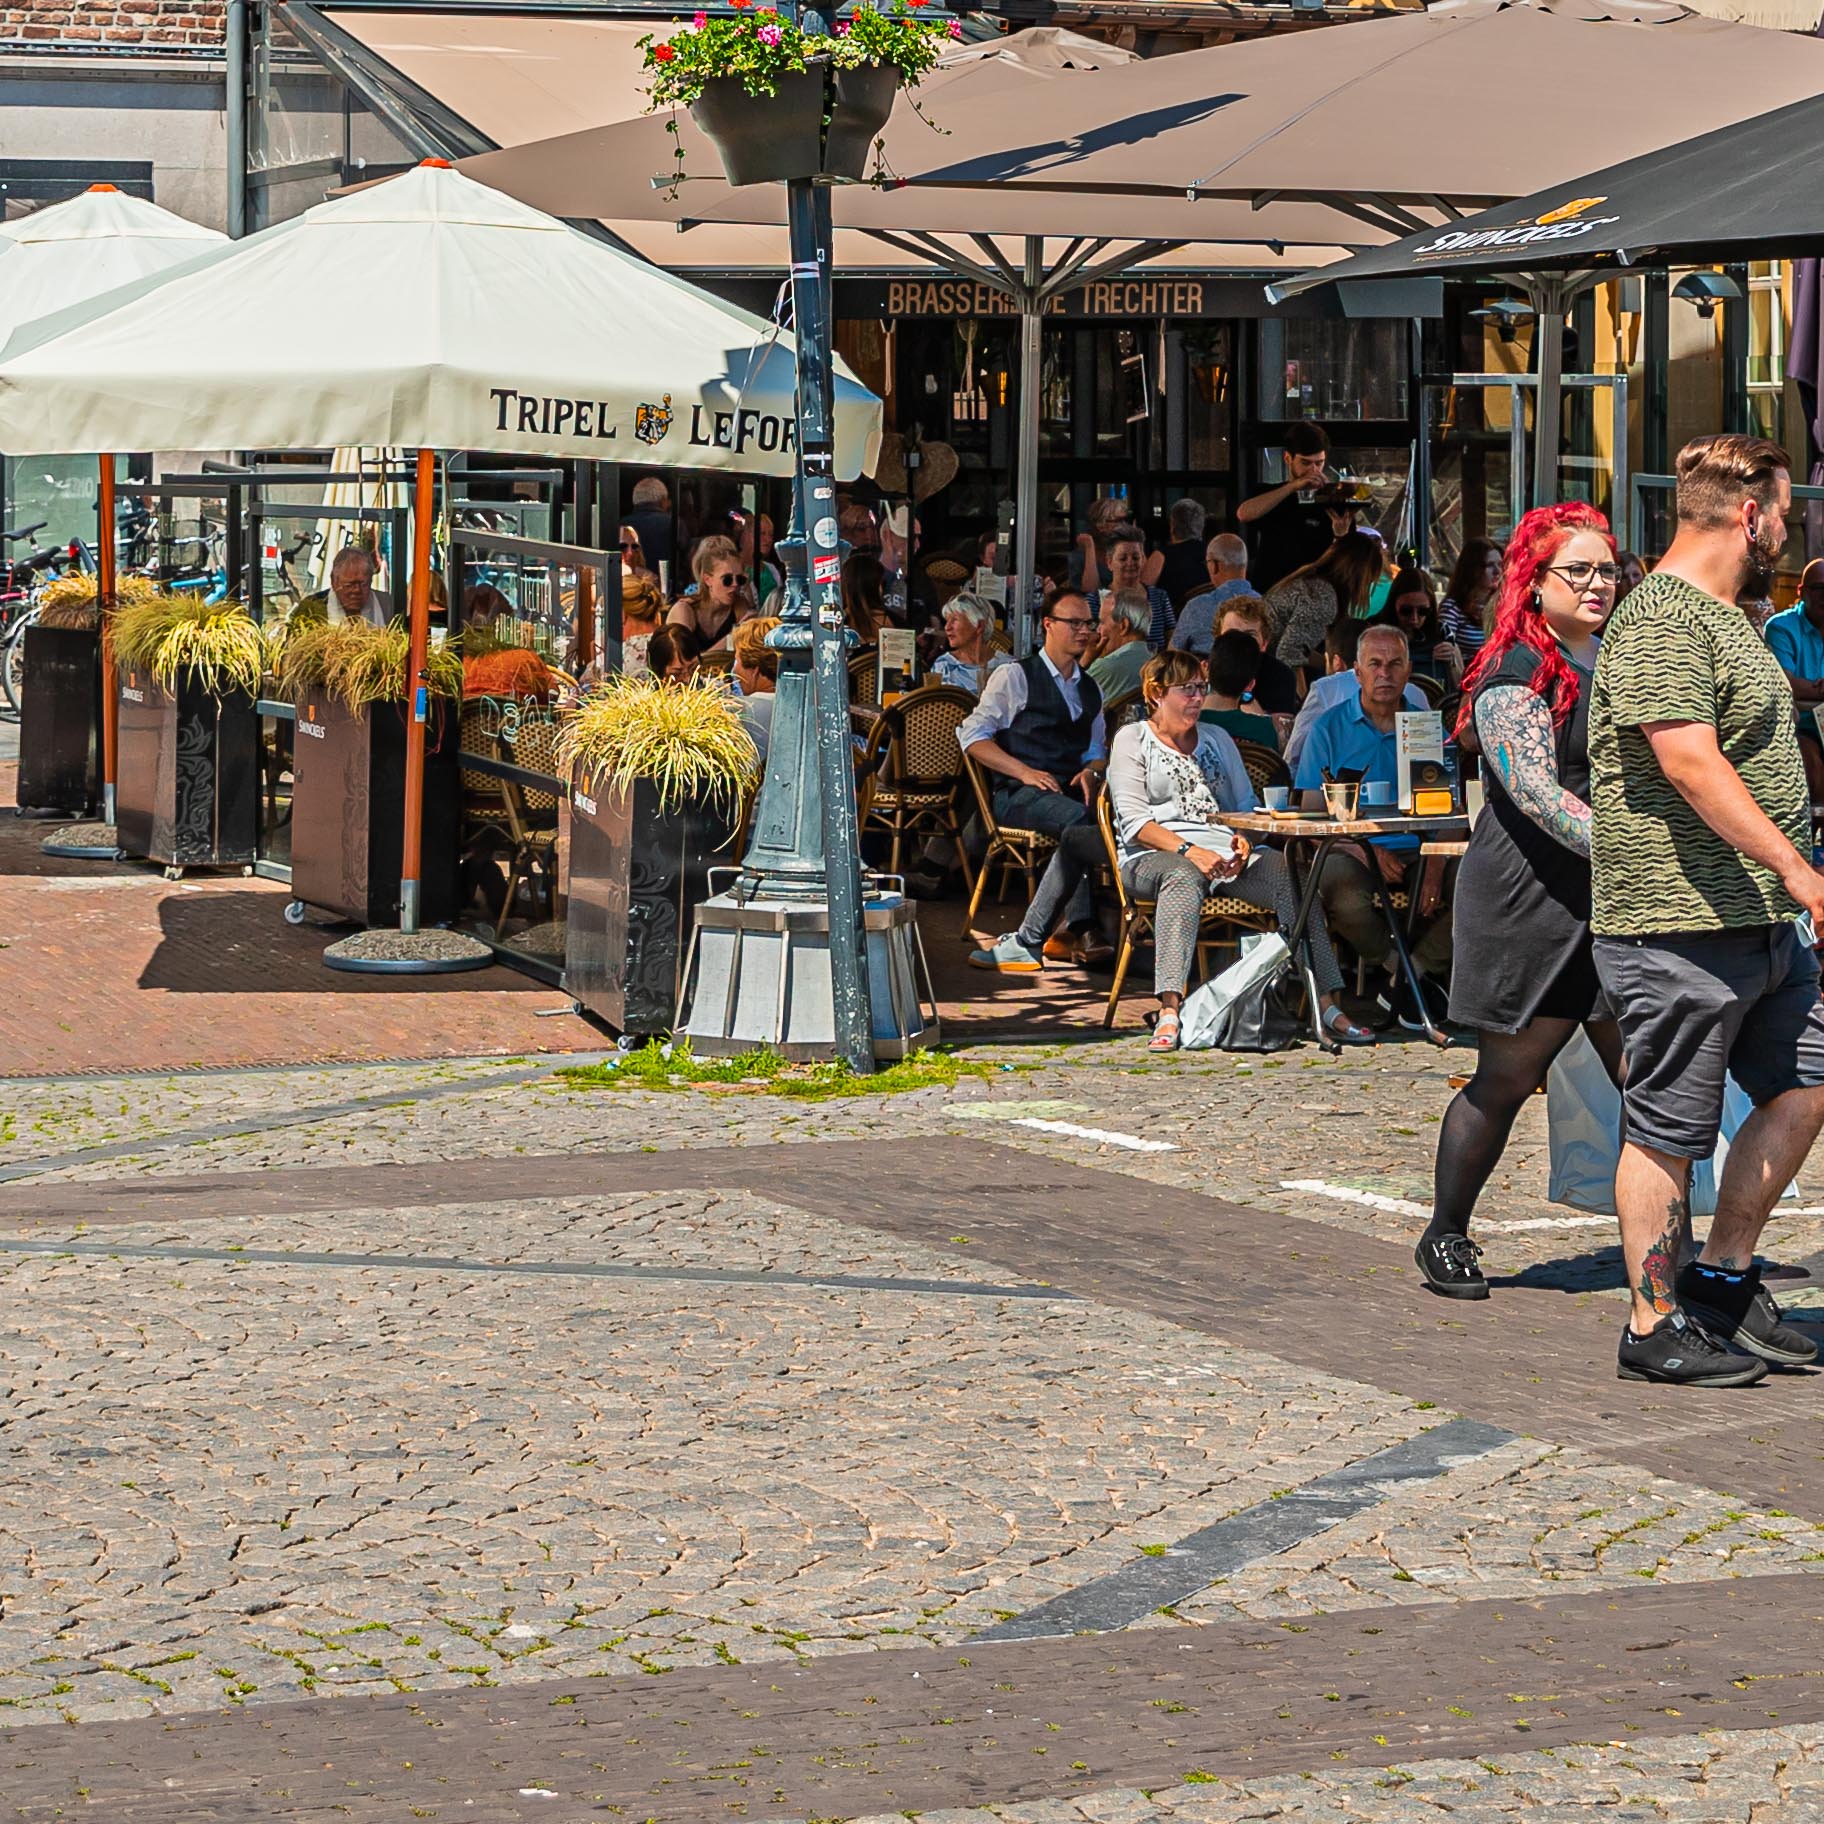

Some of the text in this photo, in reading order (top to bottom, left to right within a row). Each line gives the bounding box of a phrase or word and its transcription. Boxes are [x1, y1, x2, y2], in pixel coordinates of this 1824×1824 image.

[1082, 282, 1203, 314] TRECHTER
[489, 388, 797, 454] TRIPEL LEFOR
